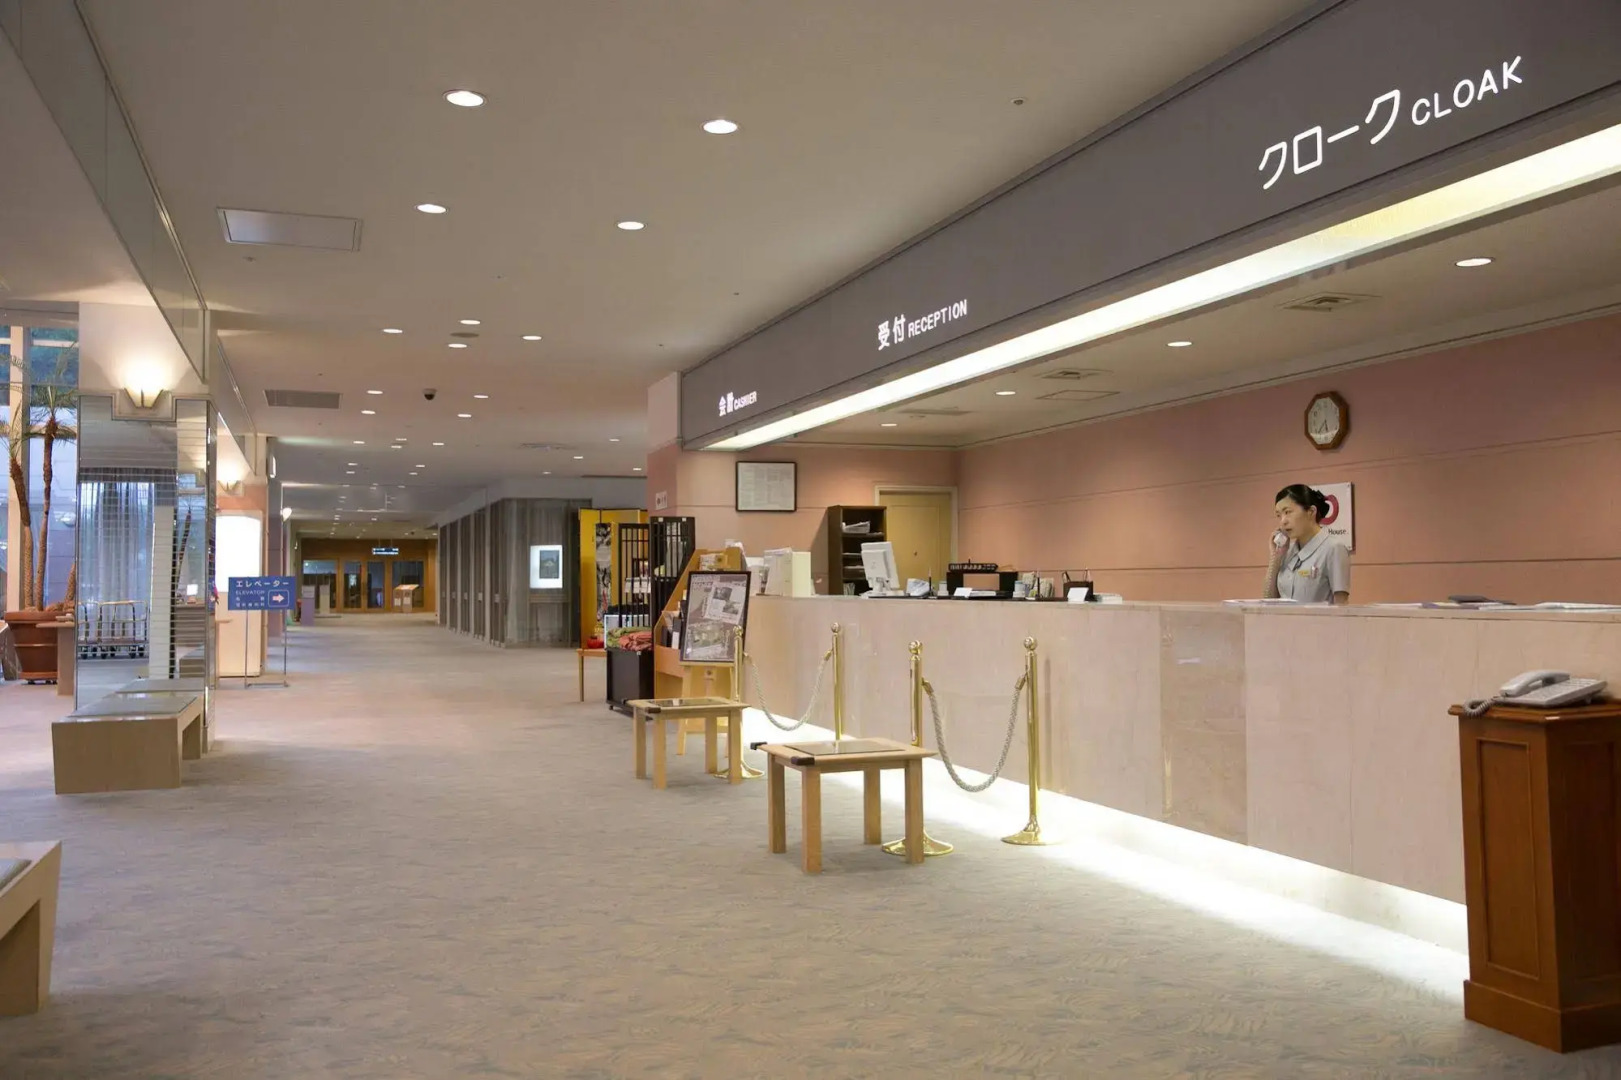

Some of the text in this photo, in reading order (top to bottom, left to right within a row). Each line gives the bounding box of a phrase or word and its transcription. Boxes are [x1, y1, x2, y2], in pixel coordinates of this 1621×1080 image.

[1258, 55, 1523, 190] クローク CLOAK
[877, 298, 968, 351] 受付 RECEPTION
[235, 579, 289, 588] エレベーター
